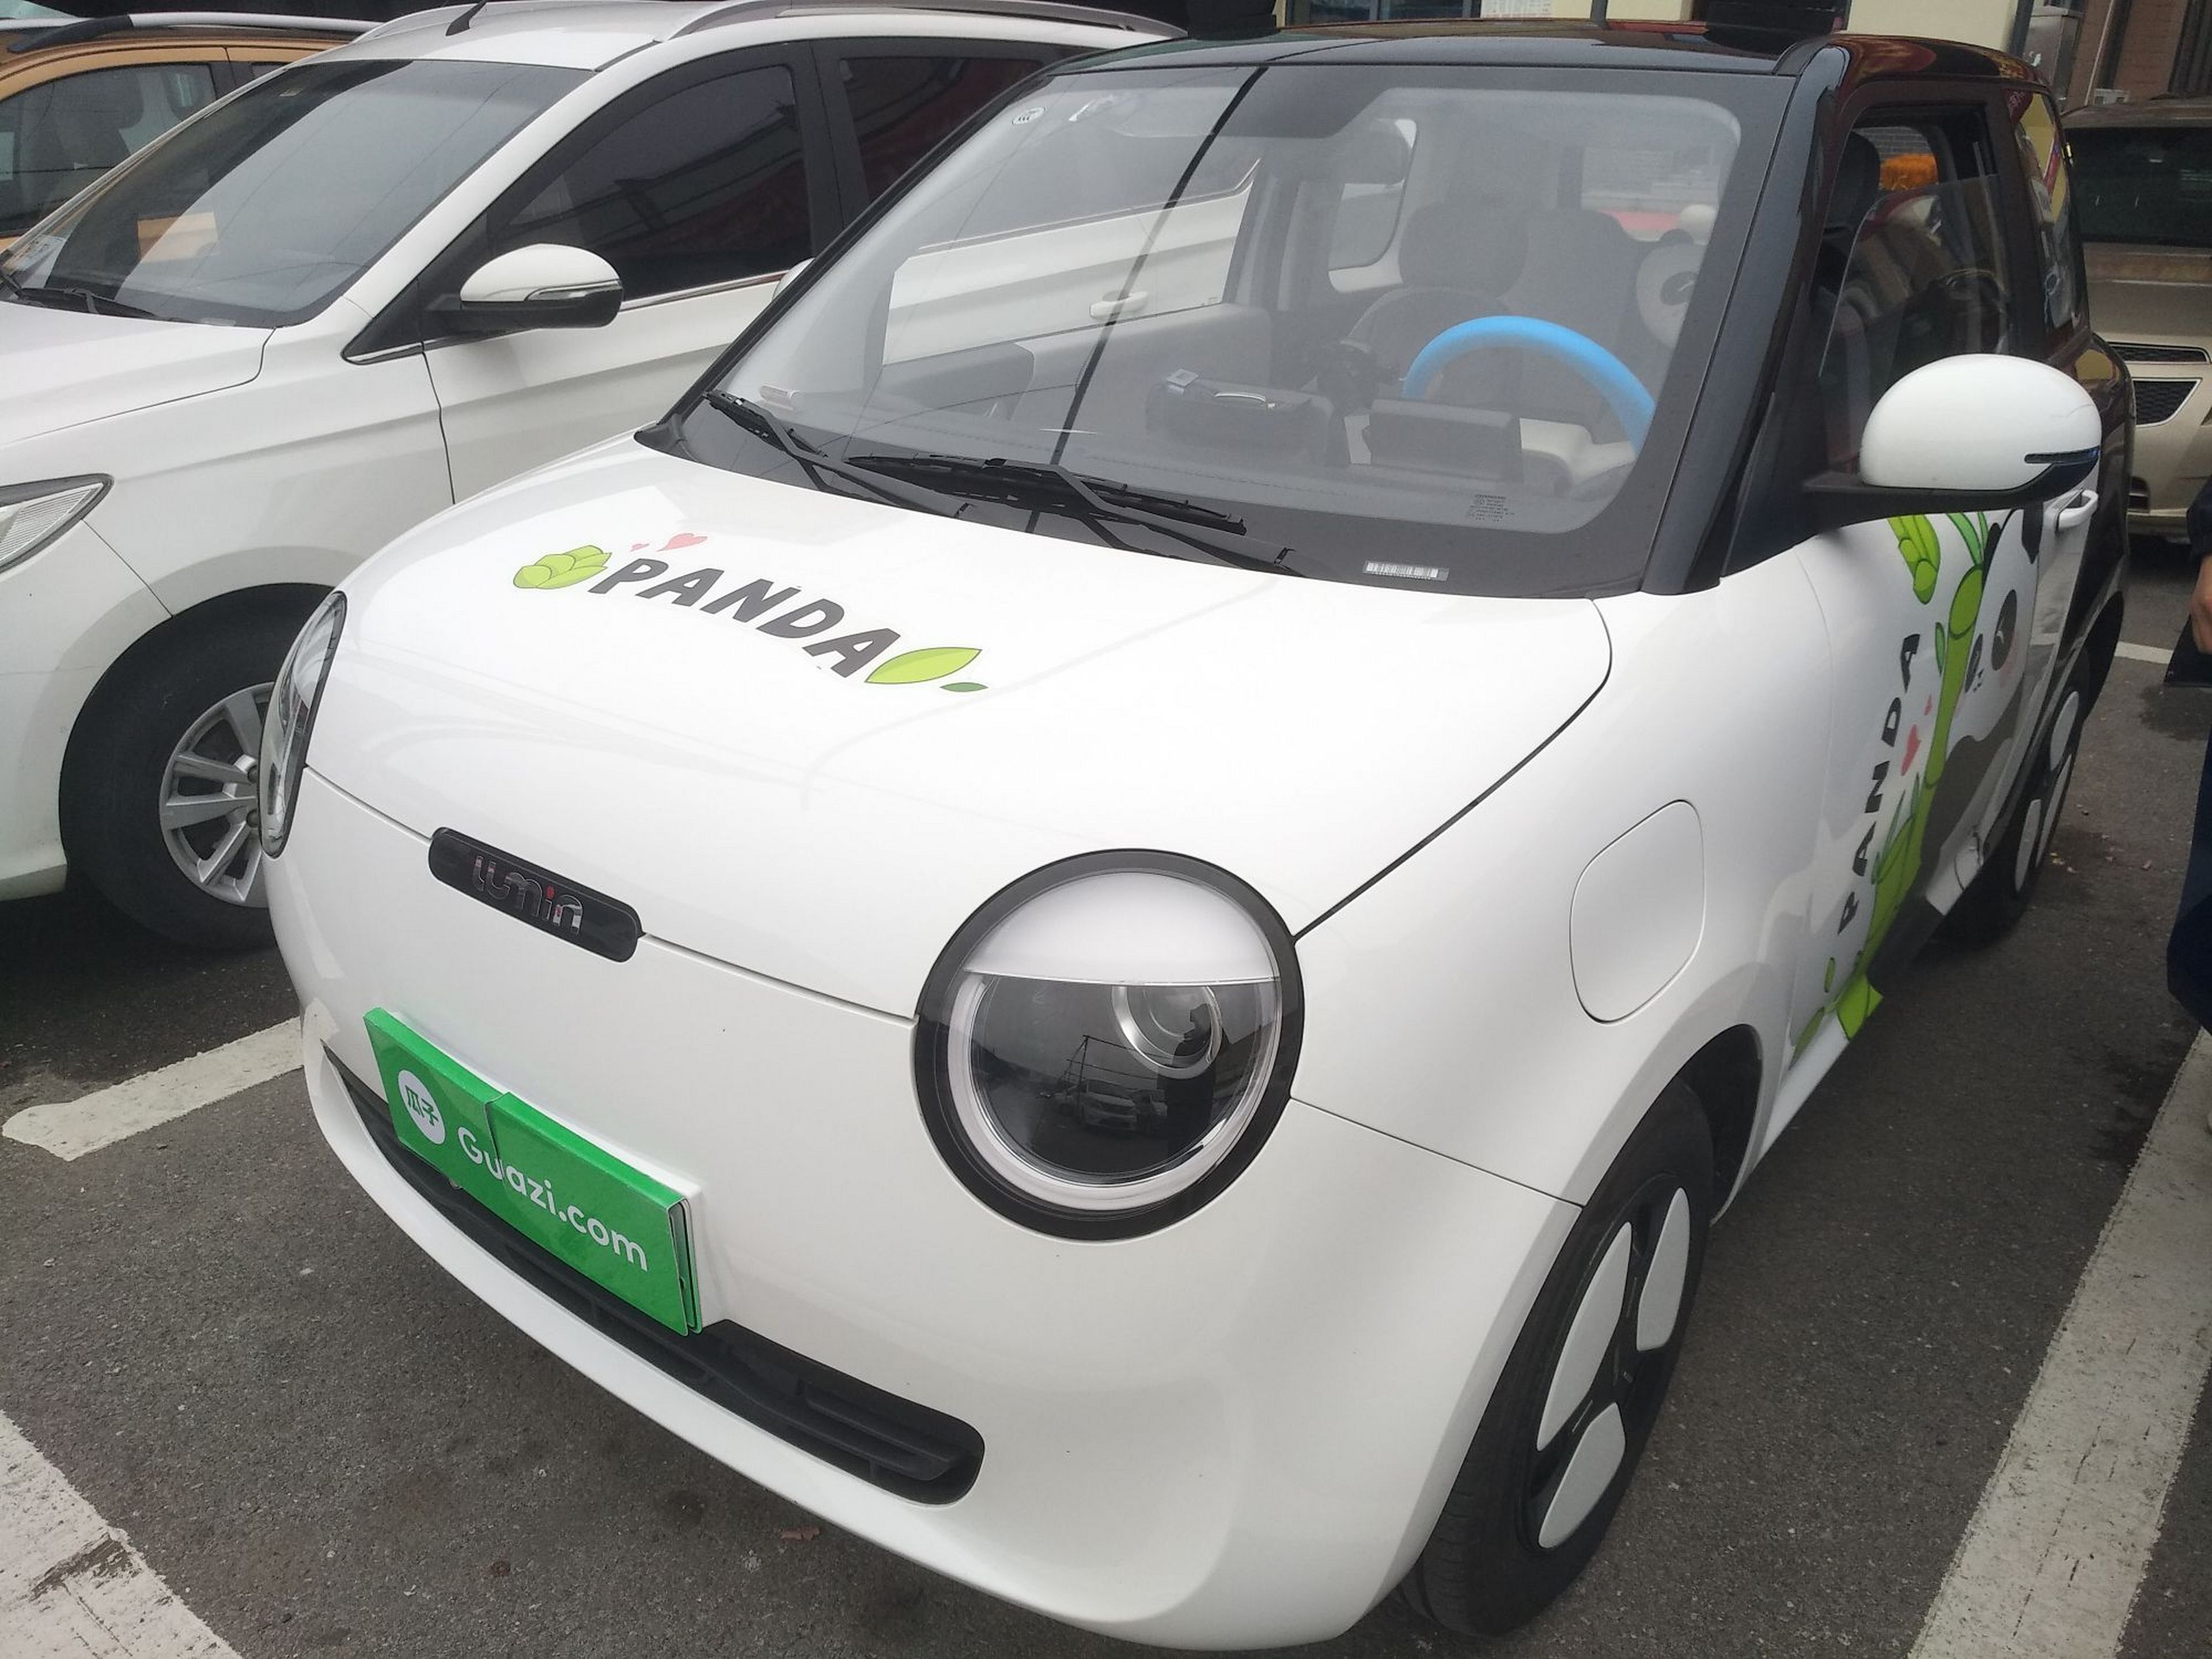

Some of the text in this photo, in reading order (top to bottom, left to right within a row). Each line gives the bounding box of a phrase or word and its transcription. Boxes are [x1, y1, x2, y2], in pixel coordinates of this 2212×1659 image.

[588, 558, 901, 679] PANDA
[1838, 634, 1920, 934] PANDA
[404, 1084, 440, 1126] 瓜子
[457, 1127, 649, 1272] Guazi.com
